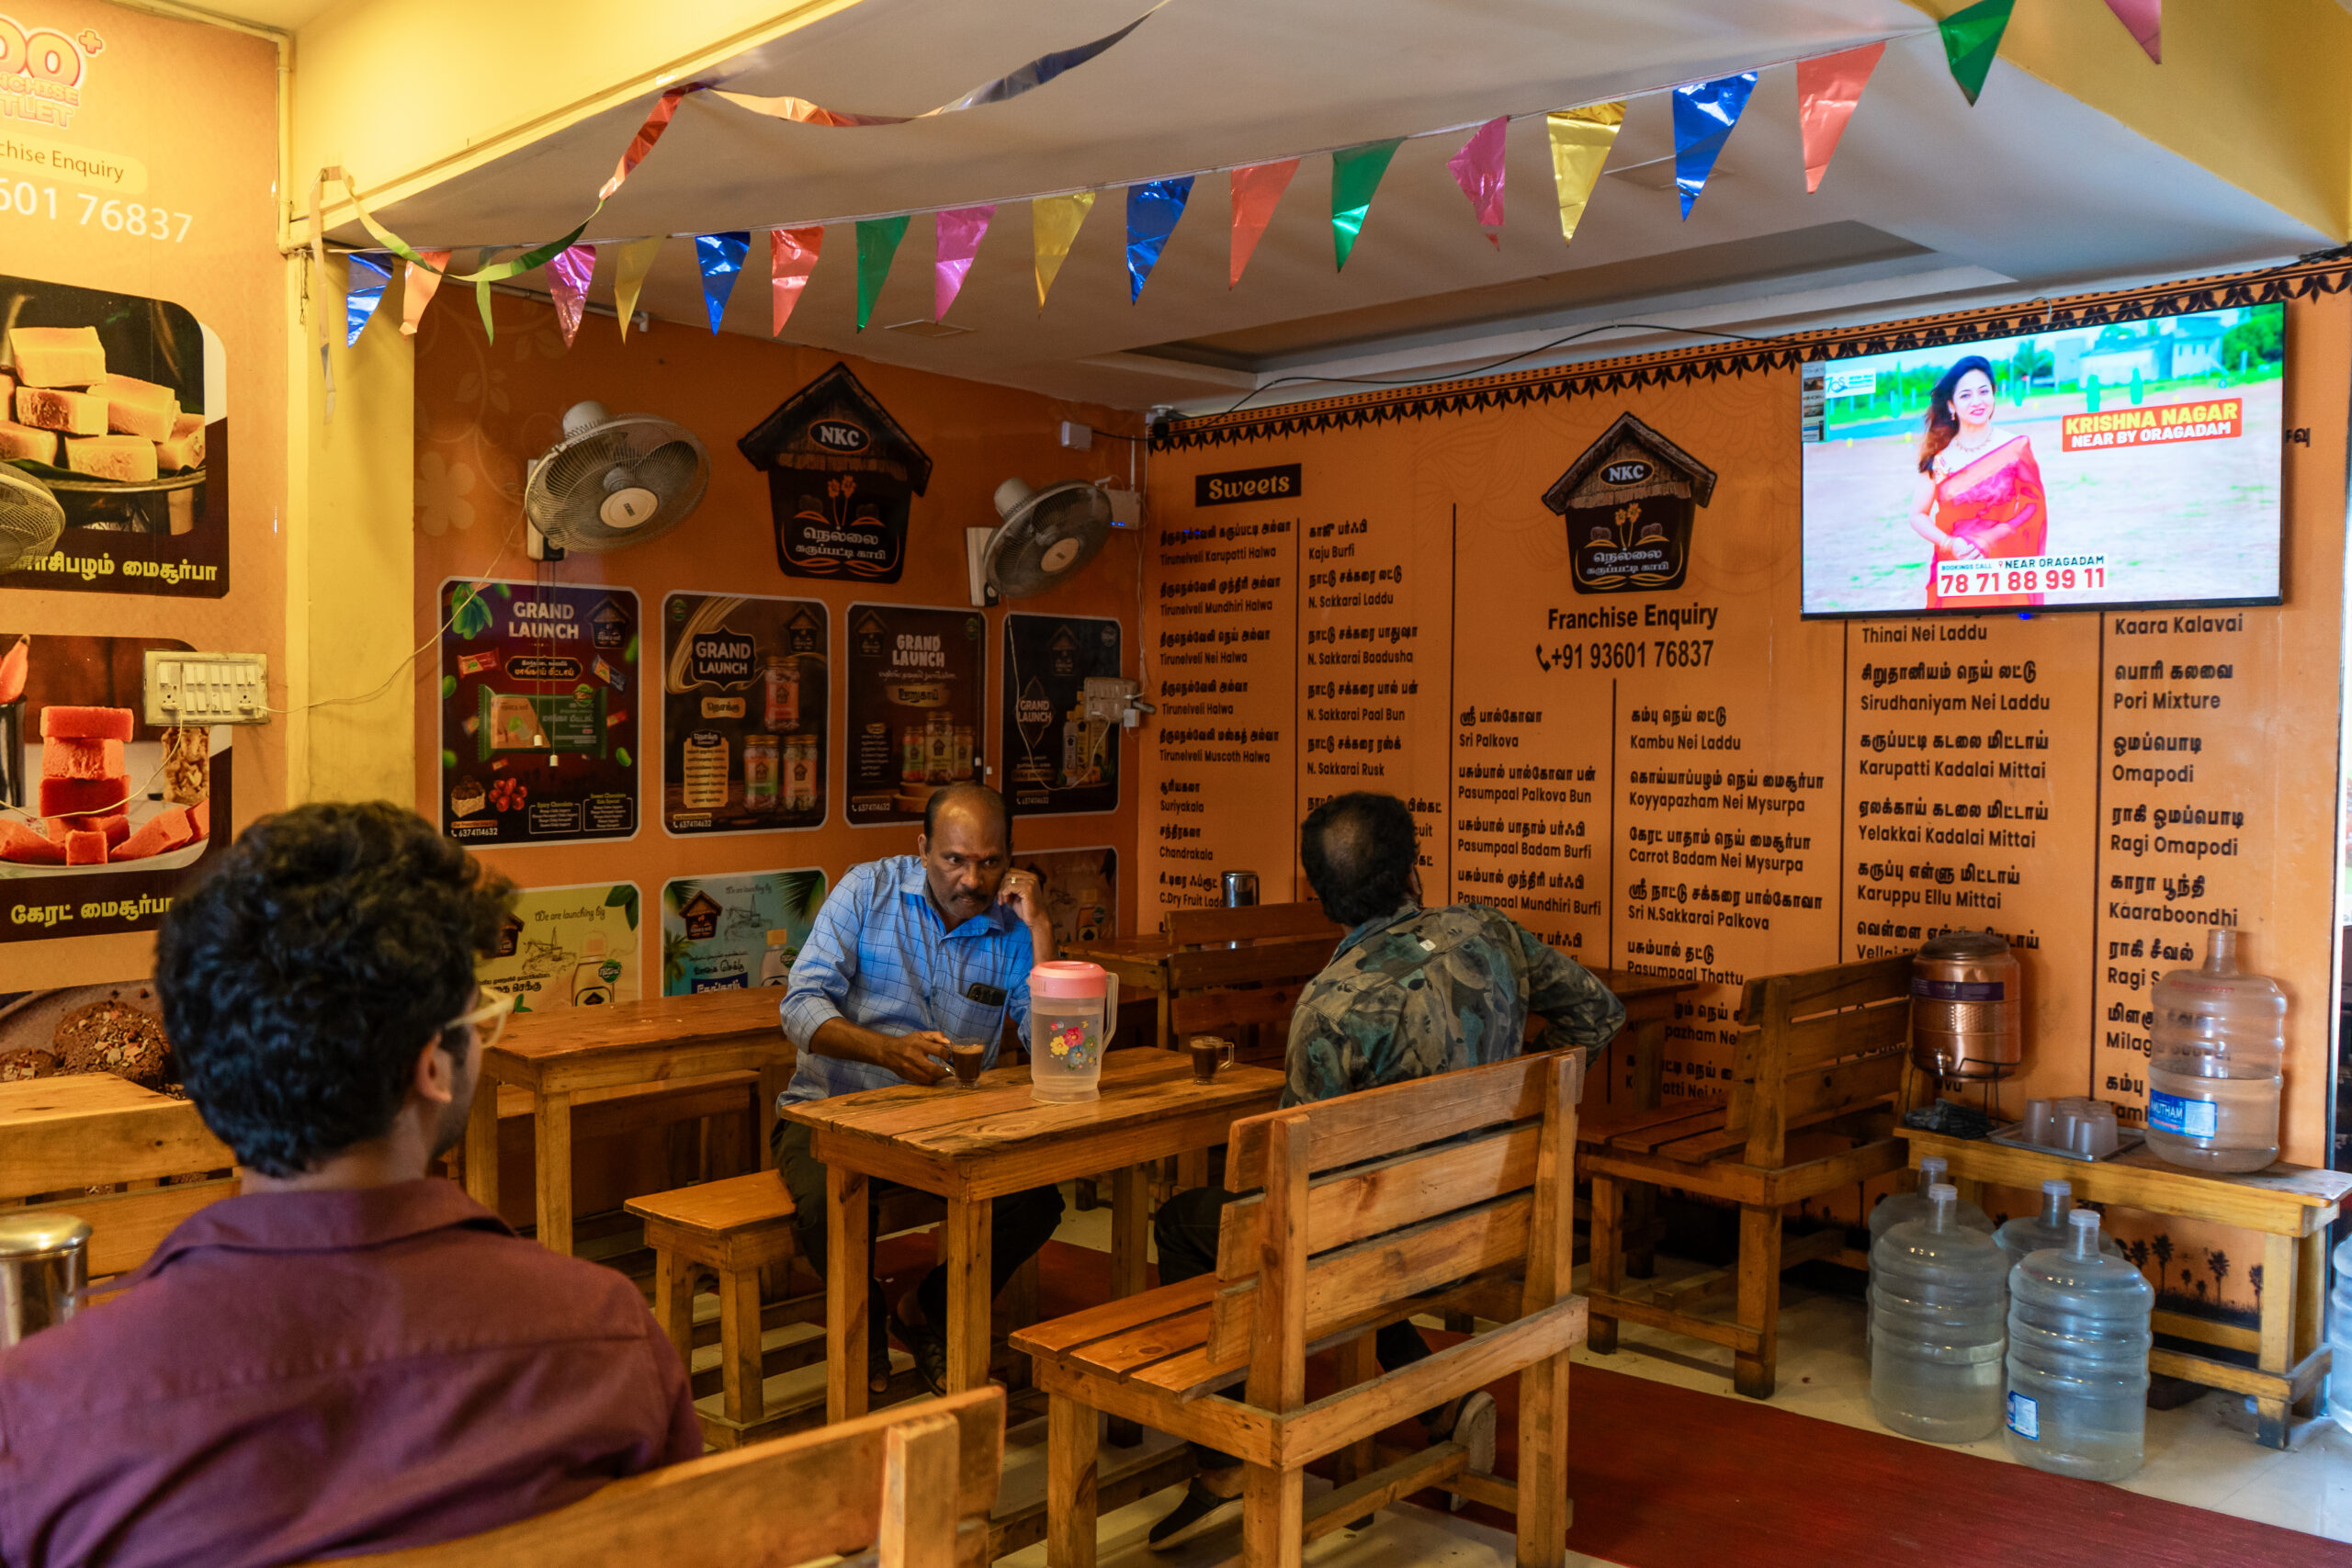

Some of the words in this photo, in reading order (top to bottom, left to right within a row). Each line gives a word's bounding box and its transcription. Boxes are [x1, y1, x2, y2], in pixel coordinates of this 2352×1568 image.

[52, 150, 124, 184] Enquiry
[77, 192, 193, 243] 76837
[2066, 411, 2154, 434] KRISHNA
[2160, 403, 2237, 425] NAGAR
[820, 425, 859, 446] NKC
[2071, 433, 2113, 448] NEAR
[2116, 431, 2136, 445] BY
[2140, 422, 2231, 442] ORAGADAM
[1609, 465, 1645, 482] NKC
[1209, 475, 1290, 500] Sweets
[1160, 551, 1203, 565] Tirunelveli
[1205, 547, 1246, 564] Karupatti
[1249, 547, 1276, 558] Halwa
[1309, 546, 1329, 562] Kaju
[1332, 544, 1354, 558] Burfi
[122, 558, 218, 584] மைசூர்பா
[2006, 559, 2035, 569] NEAR
[2039, 556, 2104, 568] ORAGADAM
[1941, 573, 1969, 594] 78
[1976, 572, 1999, 592] 71
[2007, 570, 2038, 591] 88
[2045, 569, 2075, 590] 99
[2085, 568, 2104, 588] 11
[1161, 603, 1203, 615] Tirunelveli
[1205, 599, 1243, 613] Mundhiri
[1246, 599, 1272, 611] Halwa
[1309, 597, 1317, 608] N.
[1320, 592, 1361, 608] Sakkarai
[1363, 592, 1393, 605] Laddu
[514, 602, 574, 620] GRAND
[1548, 606, 1638, 630] Franchise
[1645, 603, 1719, 631] Enquiry
[508, 622, 579, 639] LAUNCH
[2116, 618, 2167, 635] Kaara
[2174, 613, 2243, 633] Kalavai
[897, 634, 941, 651] GRAND
[1862, 626, 1906, 643] Thinai
[1912, 625, 1935, 641] Nei
[1940, 625, 1986, 641] Laddu
[695, 642, 752, 660] GRAND
[892, 650, 944, 668] LAUNCH
[1160, 652, 1203, 665] Tirunelveli
[1205, 651, 1218, 663] Nei
[1221, 652, 1247, 663] Halwa
[1308, 653, 1317, 665] N.
[1319, 650, 1360, 665] Sakkarai
[1363, 650, 1413, 663] Baadusha
[1551, 643, 1583, 670] +91
[1590, 641, 1645, 670] 93601
[1655, 640, 1714, 668] 76837
[699, 662, 748, 675] LAUNCH
[1020, 700, 1050, 711] GRAND
[1162, 703, 1204, 715] Tirunelveli
[1207, 703, 1233, 715] Halwa
[1861, 694, 1966, 716] Sirudhaniyam
[1972, 694, 1996, 710] Nei
[2001, 694, 2050, 710] Laddu
[2114, 691, 2147, 709] Pori
[2154, 691, 2220, 708] Mixture
[1017, 711, 1052, 723] LAUNCH
[1307, 709, 1316, 720] N.
[1318, 707, 1360, 720] Sakkarai
[1363, 708, 1383, 720] Paal
[1386, 708, 1405, 720] Bun
[1460, 733, 1473, 747] Sri
[1476, 734, 1519, 747] Palkova
[1631, 735, 1674, 749] Kambu
[1678, 734, 1697, 750] Nei
[1702, 735, 1740, 750] Laddu
[1159, 750, 1202, 761] Tirunelveli
[1204, 750, 1240, 761] Muscoth
[1243, 750, 1270, 762] Halwa
[1307, 762, 1316, 774] N.
[1318, 762, 1359, 775] Sakkarai
[1363, 763, 1384, 776] Rusk
[1860, 760, 1929, 780] Karupatti
[1935, 761, 1994, 777] Kadalai
[1999, 761, 2045, 778] Mittai
[2113, 764, 2193, 787] Omapodi
[1459, 785, 1519, 804] Pasumpaal
[1522, 787, 1566, 802] Palkova
[1570, 789, 1591, 803] Bun
[1160, 800, 1204, 815] Suriyakala
[1630, 792, 1718, 811] Koyyapazham
[1724, 794, 1743, 808] Nei
[1747, 795, 1804, 816] Mysurpa
[1859, 825, 1921, 842] Yelakkai
[1926, 828, 1984, 845] Kadalai
[1989, 829, 2035, 848] Mittai
[1159, 846, 1213, 860] Chandrakala
[1458, 839, 1518, 857] Pasumpaal
[1521, 842, 1560, 856] Badam
[1565, 844, 1591, 858] Burfi
[2111, 834, 2148, 857] Ragi
[2154, 836, 2237, 860] Omapodi
[1630, 848, 1668, 863] Carrot
[1673, 851, 1717, 866] Badam
[1721, 852, 1741, 867] Nei
[1746, 854, 1803, 875] Mysurpa
[1183, 894, 1202, 906] Fruit
[1858, 886, 1920, 908] Karuppu
[1926, 889, 1951, 906] Ellu
[1956, 890, 2001, 908] Mittai
[563, 908, 594, 921] launching
[595, 906, 605, 920] big
[1521, 897, 1571, 913] Mundhiri
[1574, 900, 1601, 916] Burfi
[2109, 902, 2237, 926] Kaaraboondhi
[11, 904, 74, 928] கேரட்
[1629, 905, 1644, 919] Sri
[1647, 907, 1713, 925] N.Sakkarai
[1718, 912, 1769, 930] Palkova
[1702, 967, 1744, 986] Thattu
[2109, 967, 2145, 990] Ragi
